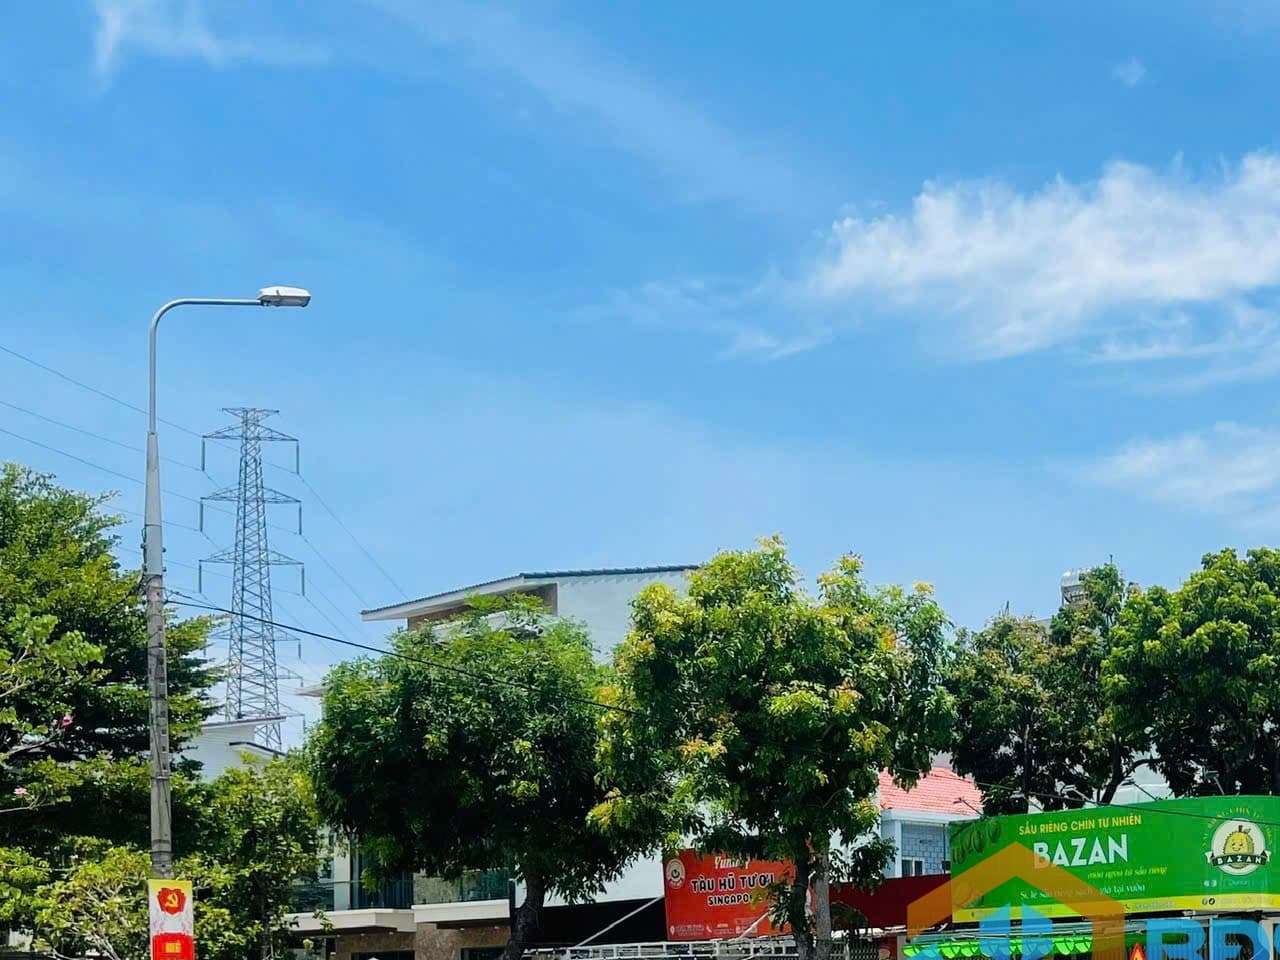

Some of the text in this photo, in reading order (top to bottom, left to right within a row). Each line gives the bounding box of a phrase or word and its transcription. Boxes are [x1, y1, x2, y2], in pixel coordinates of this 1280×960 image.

[1033, 833, 1129, 870] BAZAN
[1217, 855, 1262, 865] BAZAN
[691, 874, 715, 893] TÀU
[707, 892, 753, 906] SINGAPO
